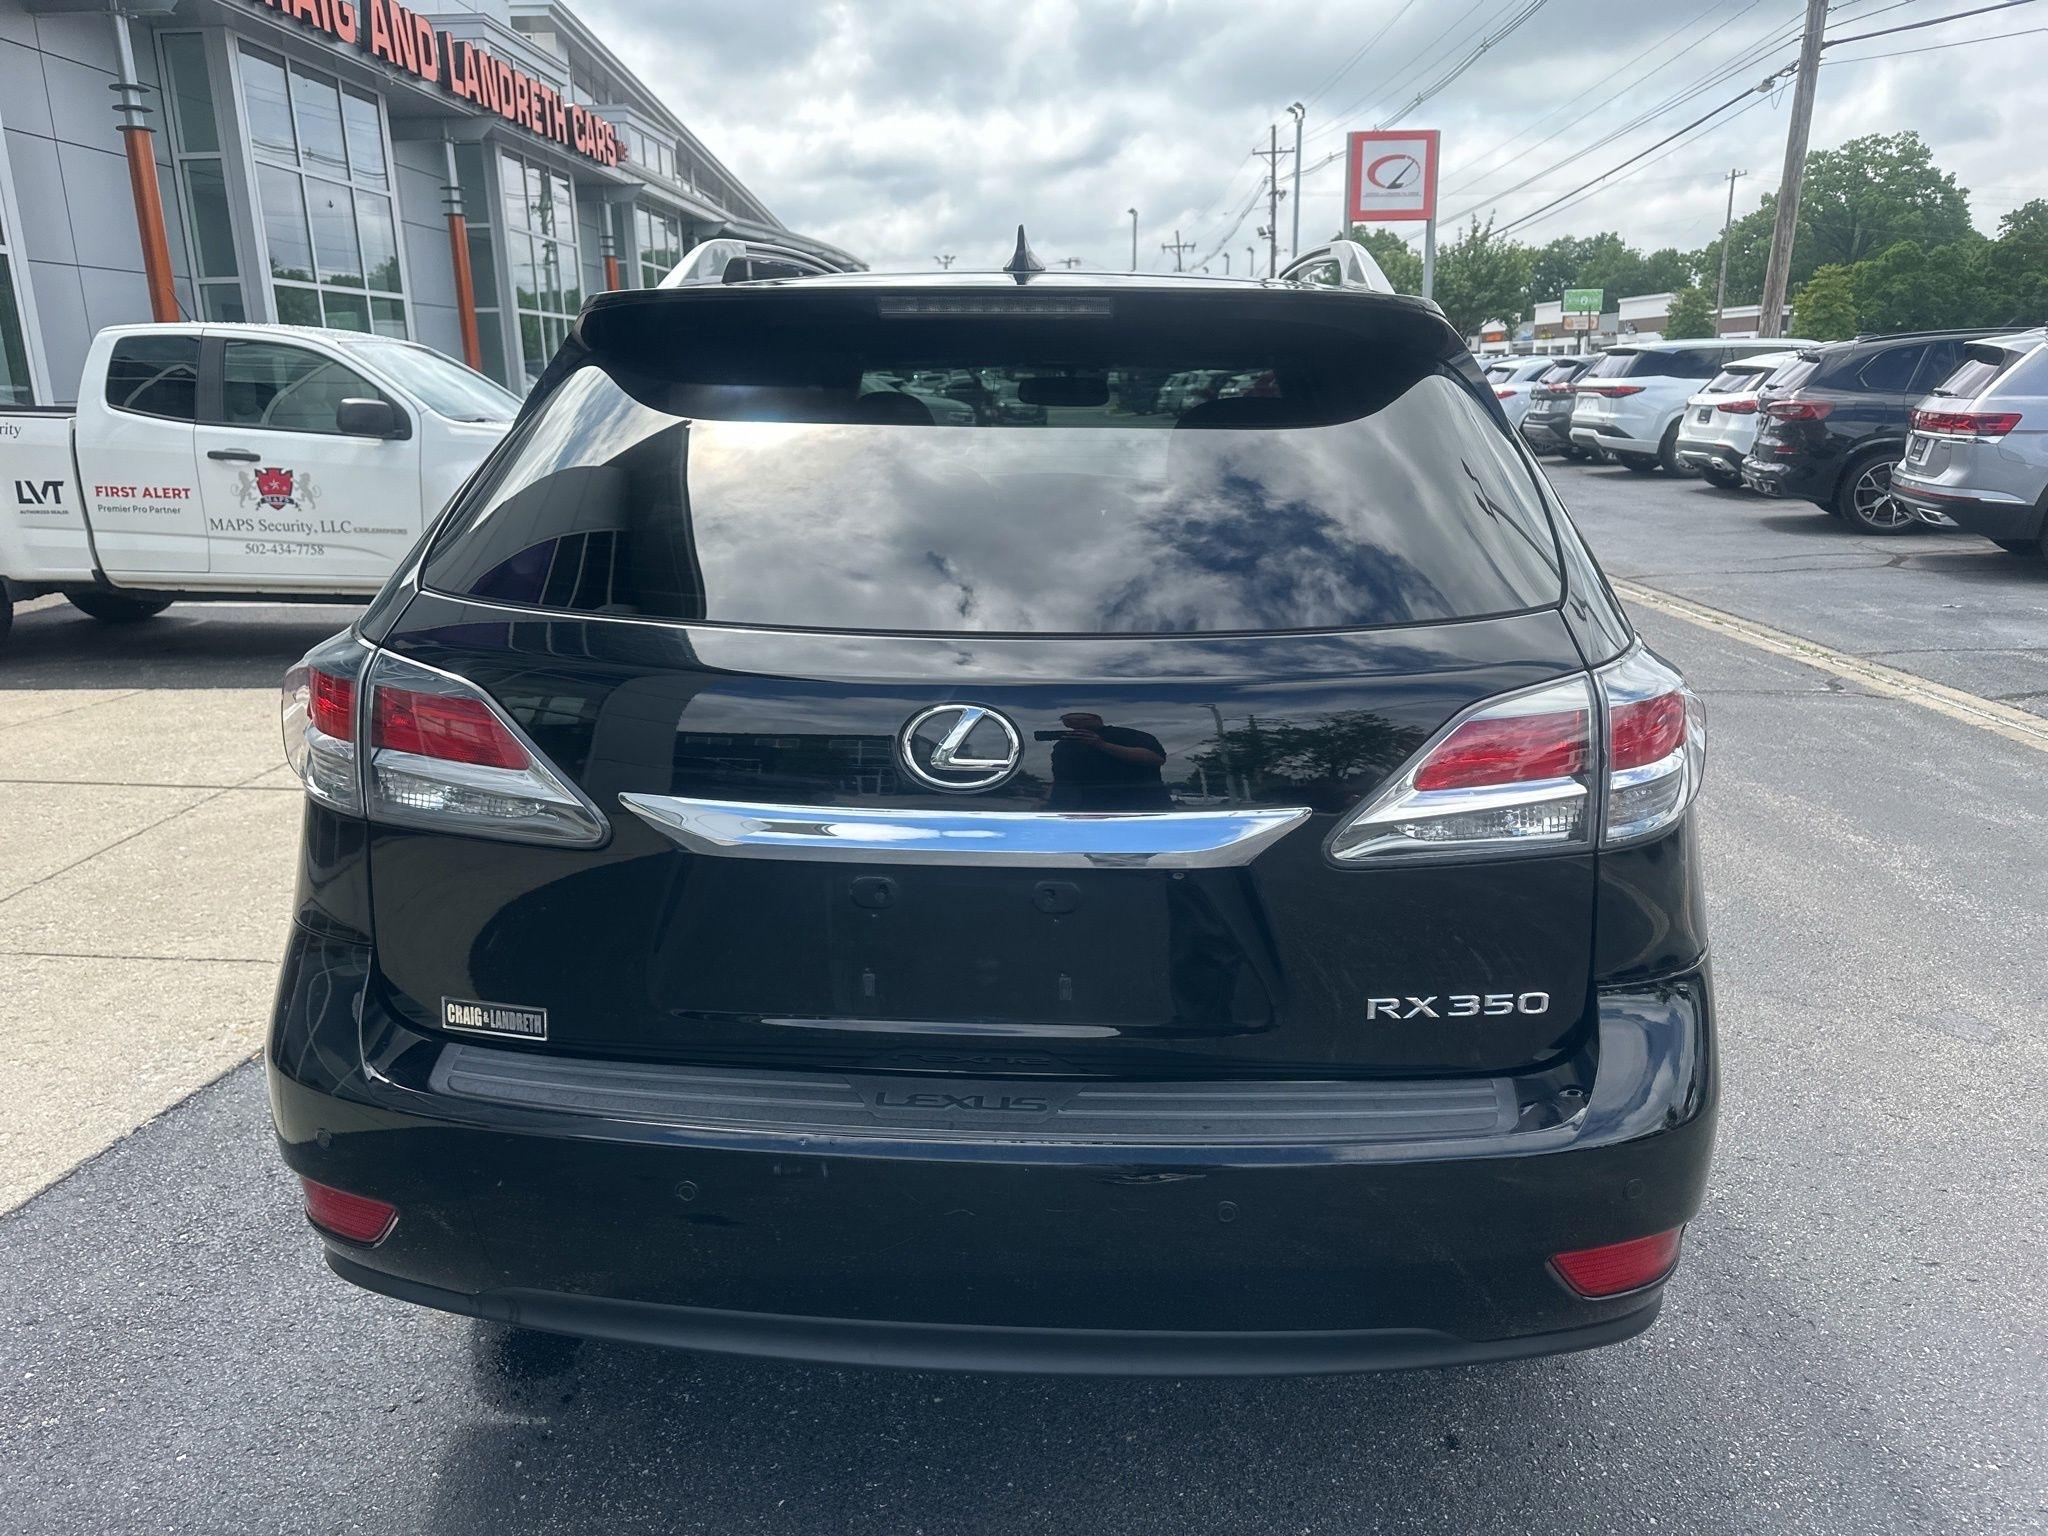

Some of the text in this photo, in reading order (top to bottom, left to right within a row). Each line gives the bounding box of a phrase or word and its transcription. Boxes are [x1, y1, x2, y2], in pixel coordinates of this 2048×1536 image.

[370, 0, 438, 82] AND
[446, 31, 568, 145] LANDRETH
[572, 103, 617, 168] CARS
[15, 480, 64, 504] LVT
[95, 485, 191, 500] FIRST ALERT
[97, 504, 181, 515] Premier Pro Partner
[210, 518, 254, 532] MAPS
[259, 519, 318, 536] Security,
[321, 521, 352, 534] LLC
[245, 543, 325, 556] 502-434-7758
[1366, 991, 1550, 1020] RX 350
[446, 1003, 542, 1034] CRAIG & LANDRETH
[874, 1091, 1048, 1112] LEXUS
